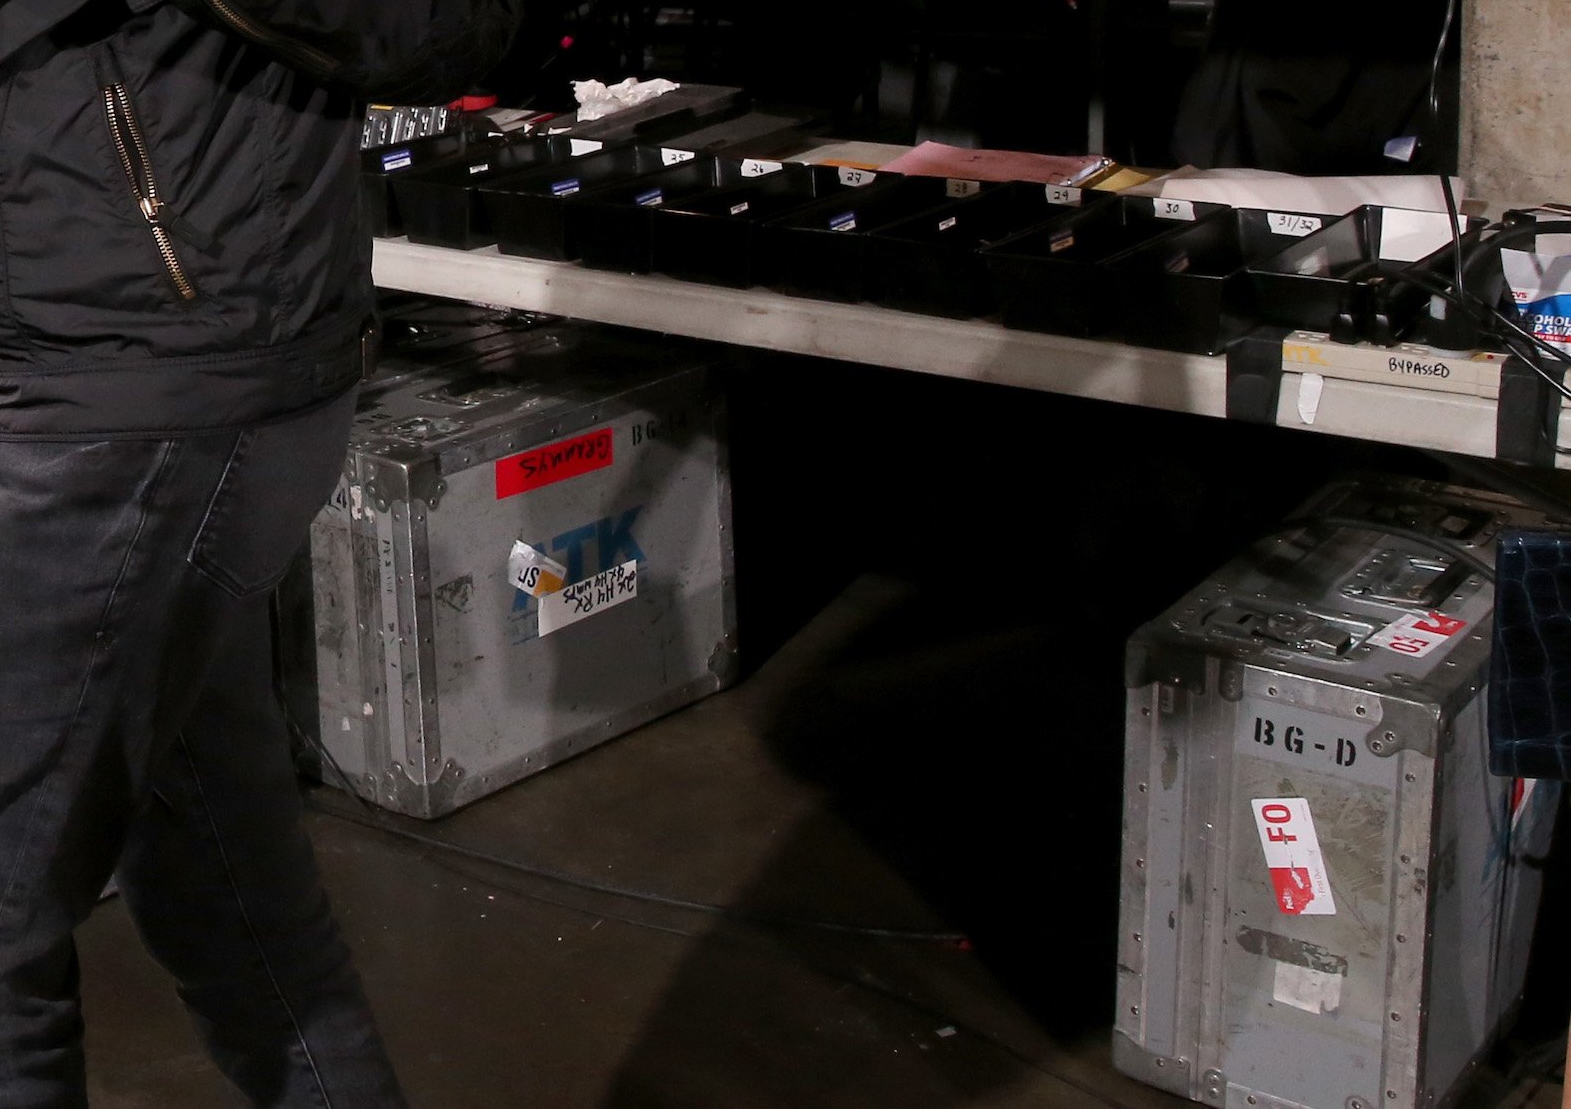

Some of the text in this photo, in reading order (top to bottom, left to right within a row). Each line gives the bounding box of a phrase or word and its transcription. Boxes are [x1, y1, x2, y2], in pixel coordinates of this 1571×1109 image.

[750, 163, 764, 174] 26
[847, 172, 862, 184] 27
[1053, 190, 1069, 201] 29
[1165, 203, 1180, 214] 30
[1279, 216, 1314, 232] 31/32
[1388, 357, 1450, 379] BYPASSED
[1261, 804, 1298, 842] FO
